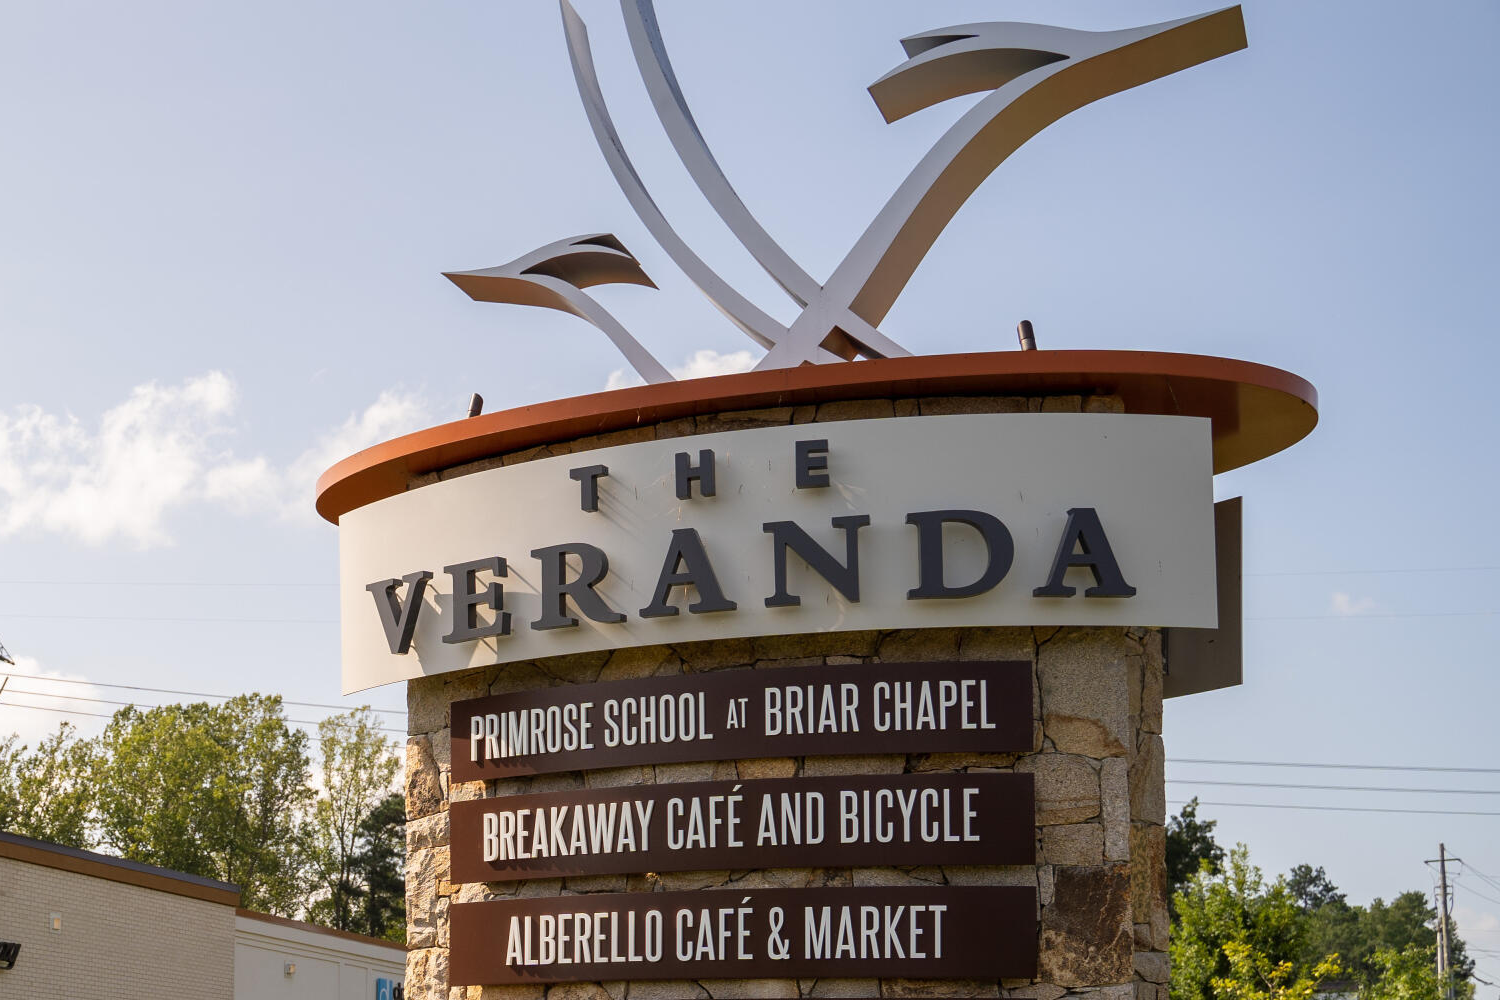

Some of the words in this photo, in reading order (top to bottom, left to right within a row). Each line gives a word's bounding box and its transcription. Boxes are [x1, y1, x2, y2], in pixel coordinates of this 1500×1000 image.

[569, 438, 832, 514] THE
[365, 507, 1138, 655] VERANDA
[470, 702, 594, 762] PRIMROSE
[604, 692, 714, 748] SCHOOL
[726, 698, 749, 729] AT
[764, 683, 860, 736] BRIAR
[873, 679, 996, 732] CHAPEL
[482, 799, 655, 863] BREAKAWAY
[667, 785, 744, 850] CAFÉ
[757, 791, 824, 847] AND
[840, 788, 980, 844] BICYCLE
[505, 909, 663, 966] ALBERELLO
[676, 897, 753, 962] CAFÉ
[767, 906, 790, 960] &
[804, 905, 947, 960] MARKET
